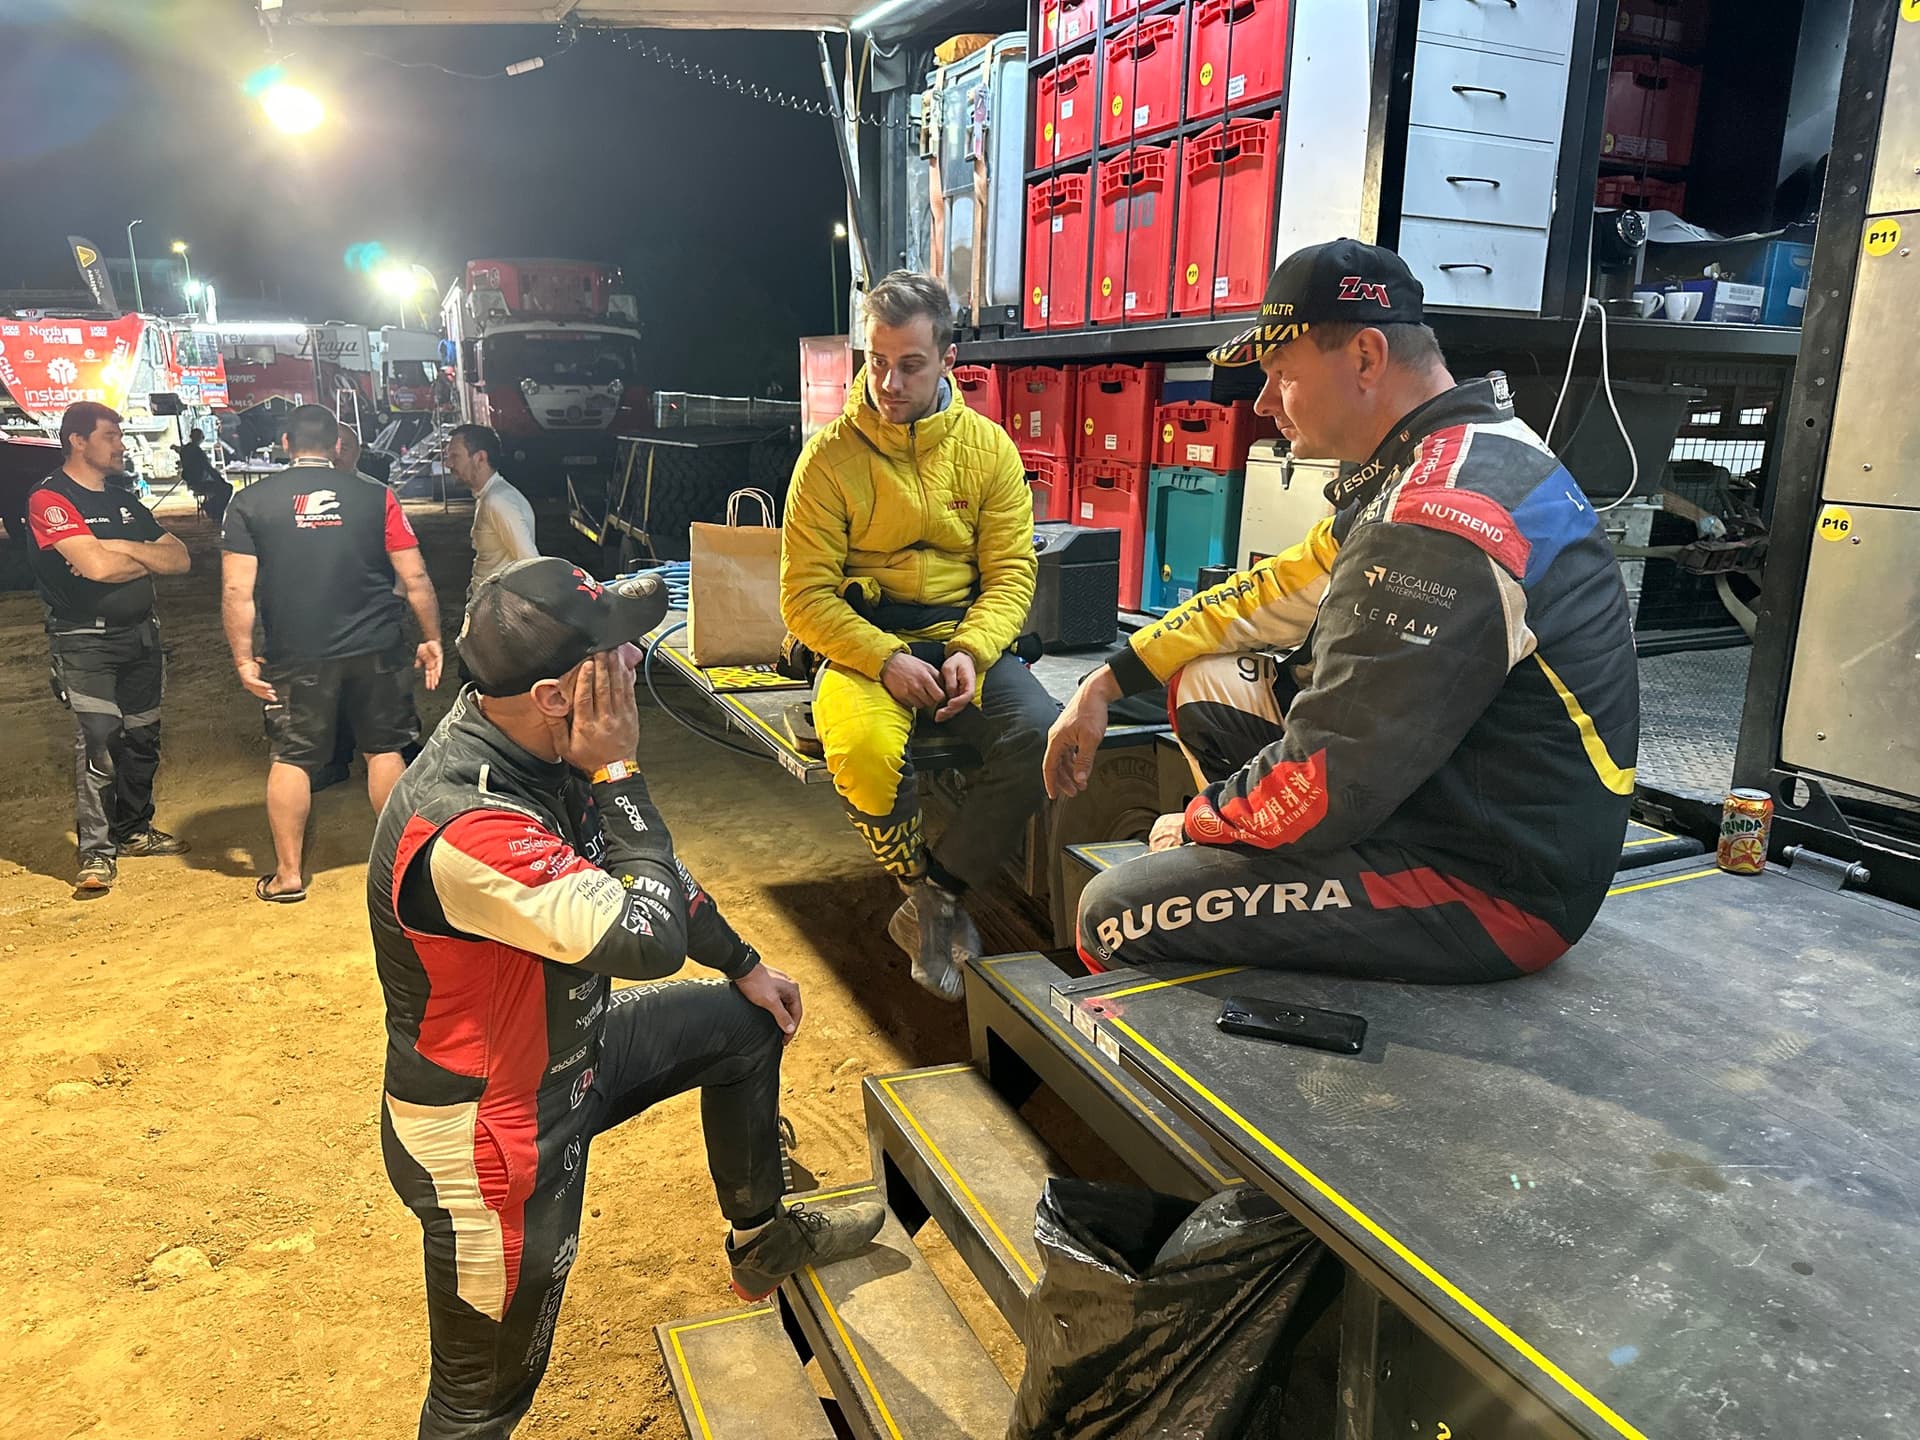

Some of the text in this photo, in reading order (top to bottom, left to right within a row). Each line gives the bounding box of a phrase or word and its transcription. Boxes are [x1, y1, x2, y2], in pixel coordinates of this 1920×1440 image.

[1868, 231, 1897, 245] P11
[1262, 304, 1294, 317] VALTR
[28, 325, 61, 337] North
[42, 334, 68, 344] Med
[295, 328, 360, 360] Praga
[1343, 459, 1385, 493] ESOX
[1421, 501, 1504, 544] NUTREND
[1821, 517, 1849, 532] P16
[1385, 584, 1453, 609] INTERNATIONAL
[1388, 571, 1457, 600] EXCALIBUR
[1096, 879, 1352, 954] BUGGYRA
